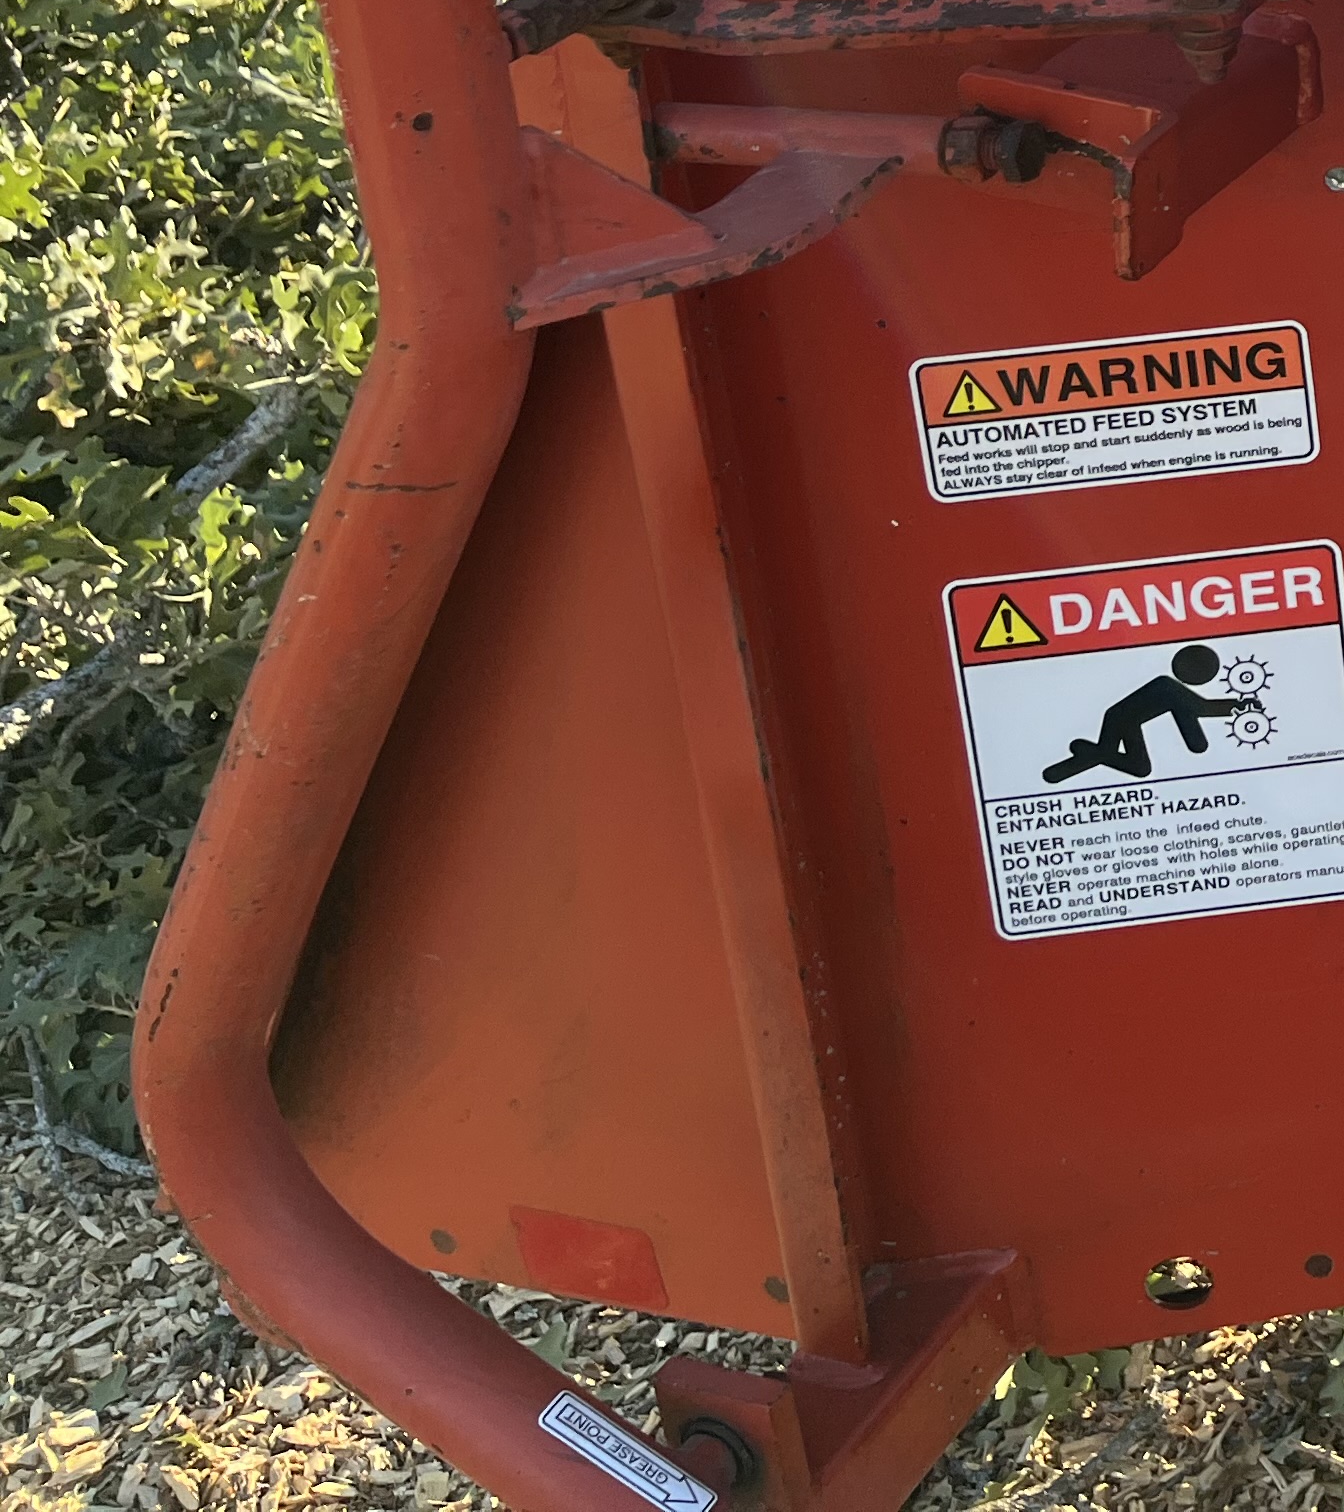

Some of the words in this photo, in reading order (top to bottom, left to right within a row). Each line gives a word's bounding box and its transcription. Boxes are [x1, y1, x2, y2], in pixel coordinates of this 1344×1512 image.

[997, 341, 1287, 407] WARNING
[936, 417, 1086, 449] AUTOMATED
[1092, 410, 1155, 432] FEED
[1161, 398, 1257, 424] SYSTEM
[937, 451, 970, 465] Feed
[972, 448, 1013, 461] works
[1015, 444, 1038, 456] will
[1041, 443, 1070, 454] stop
[1073, 437, 1098, 450] and
[1101, 435, 1131, 447] start
[1134, 428, 1193, 444] suddenly
[1196, 427, 1212, 437] as
[1214, 420, 1250, 434] wood
[1253, 420, 1265, 430] is
[1267, 416, 1302, 429] being
[940, 465, 962, 478] fed
[964, 464, 990, 475] into
[992, 461, 1014, 472] the
[943, 474, 1003, 491] ALWAYS
[1006, 474, 1034, 484] stay
[1036, 469, 1068, 480] clear
[1071, 466, 1085, 477] of
[1087, 461, 1127, 475] infeed
[1131, 459, 1166, 470] when
[1168, 453, 1212, 466] engine
[1215, 451, 1226, 460] is
[1049, 566, 1325, 636] DANGER
[994, 800, 1062, 819] CRUSH
[996, 804, 1155, 835] ENTANGLEMENT
[1000, 838, 1065, 856] NEVER
[1071, 833, 1111, 847] reach
[1115, 831, 1142, 842] into
[1145, 827, 1168, 839] the
[1177, 820, 1220, 834] infeed
[1002, 857, 1030, 872] DO
[1035, 851, 1076, 868] NOT
[1081, 850, 1116, 862] wear
[1120, 845, 1159, 857] loose
[1005, 871, 1038, 886] style
[1042, 866, 1089, 883] gloves
[1093, 863, 1108, 874] or
[1112, 857, 1159, 874] gloves
[1166, 852, 1196, 864] with
[1199, 848, 1238, 860] holes
[1241, 842, 1279, 855] while
[1006, 881, 1071, 900] NEVER
[1077, 876, 1132, 892] operate
[1136, 869, 1196, 884] machine
[1199, 863, 1236, 878] while
[1009, 897, 1062, 915] READ
[1068, 895, 1094, 907] and
[1099, 877, 1230, 903] UNDERSTAND
[1235, 871, 1302, 888] operators
[1011, 914, 1057, 928] before
[563, 1410, 611, 1445] POINT
[608, 1439, 669, 1485] GREASE
